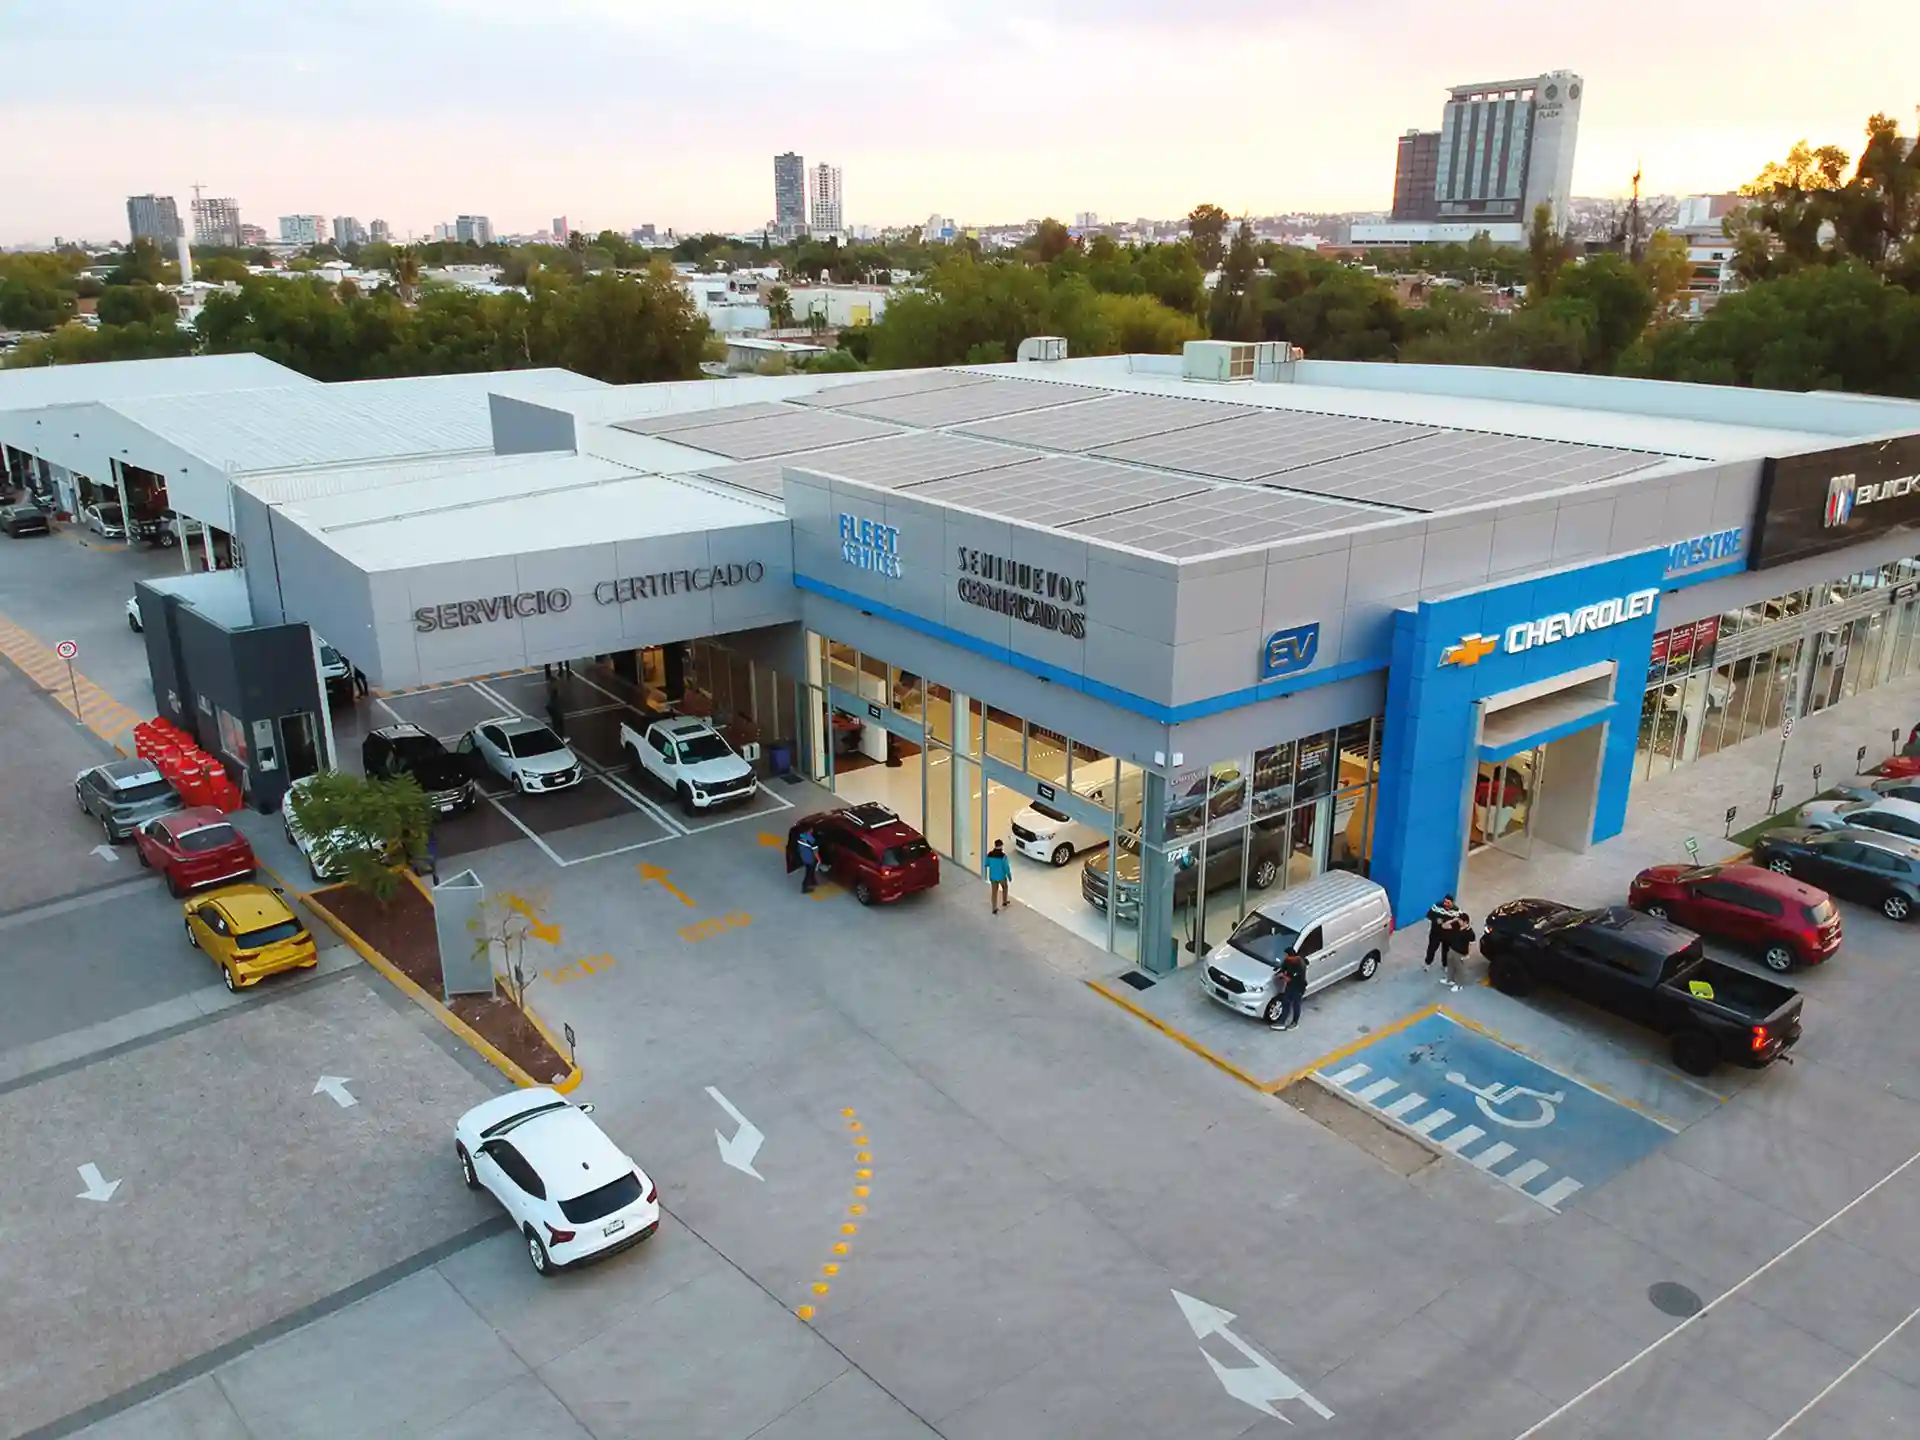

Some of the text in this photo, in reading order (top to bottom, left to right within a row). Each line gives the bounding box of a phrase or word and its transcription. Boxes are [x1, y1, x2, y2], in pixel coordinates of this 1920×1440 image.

[839, 513, 900, 554] FLEET
[415, 560, 765, 633] SERVICIO CERTIFICADO
[958, 545, 1085, 606] SEMINUEVOS
[957, 577, 1085, 639] CERTIFICADOS
[1503, 587, 1660, 655] CHEVROLET
[1269, 632, 1314, 667] EV
